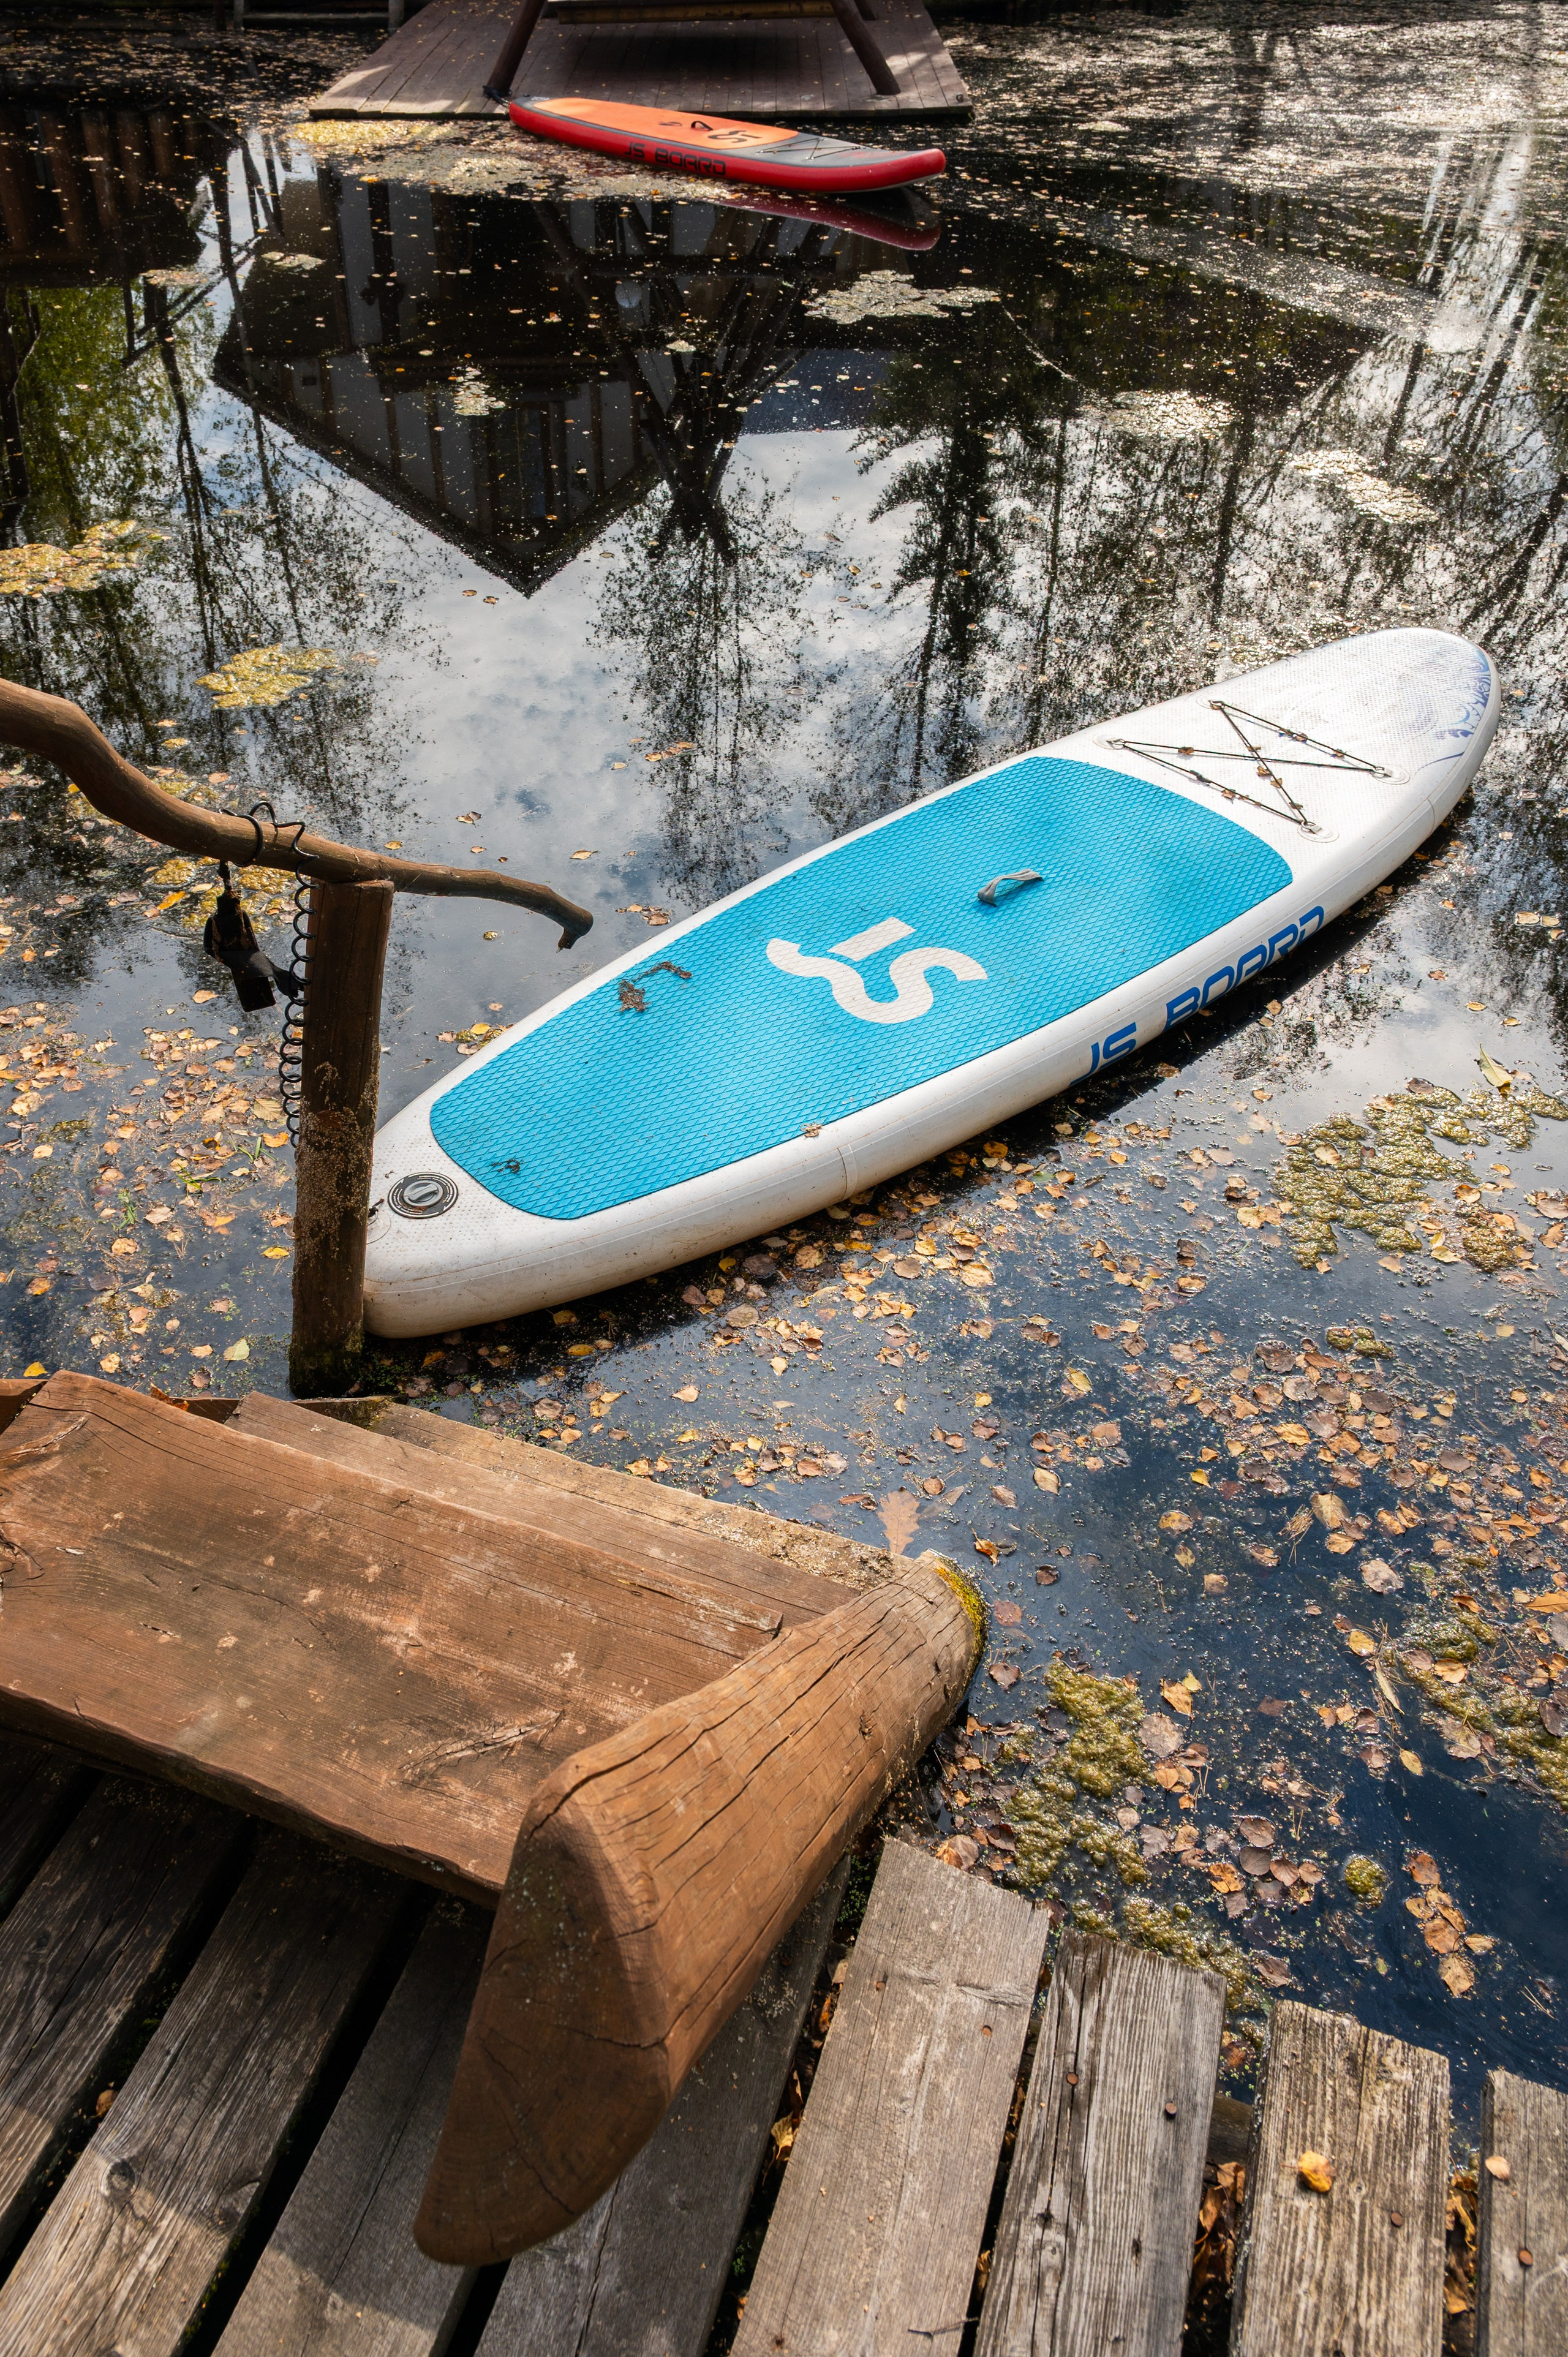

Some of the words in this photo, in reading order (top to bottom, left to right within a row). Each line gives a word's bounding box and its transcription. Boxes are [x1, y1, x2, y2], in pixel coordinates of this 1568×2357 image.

[624, 141, 645, 159] JS
[655, 147, 726, 176] BOARD
[1069, 1022, 1137, 1087] JS
[1164, 905, 1325, 1032] BOARD
